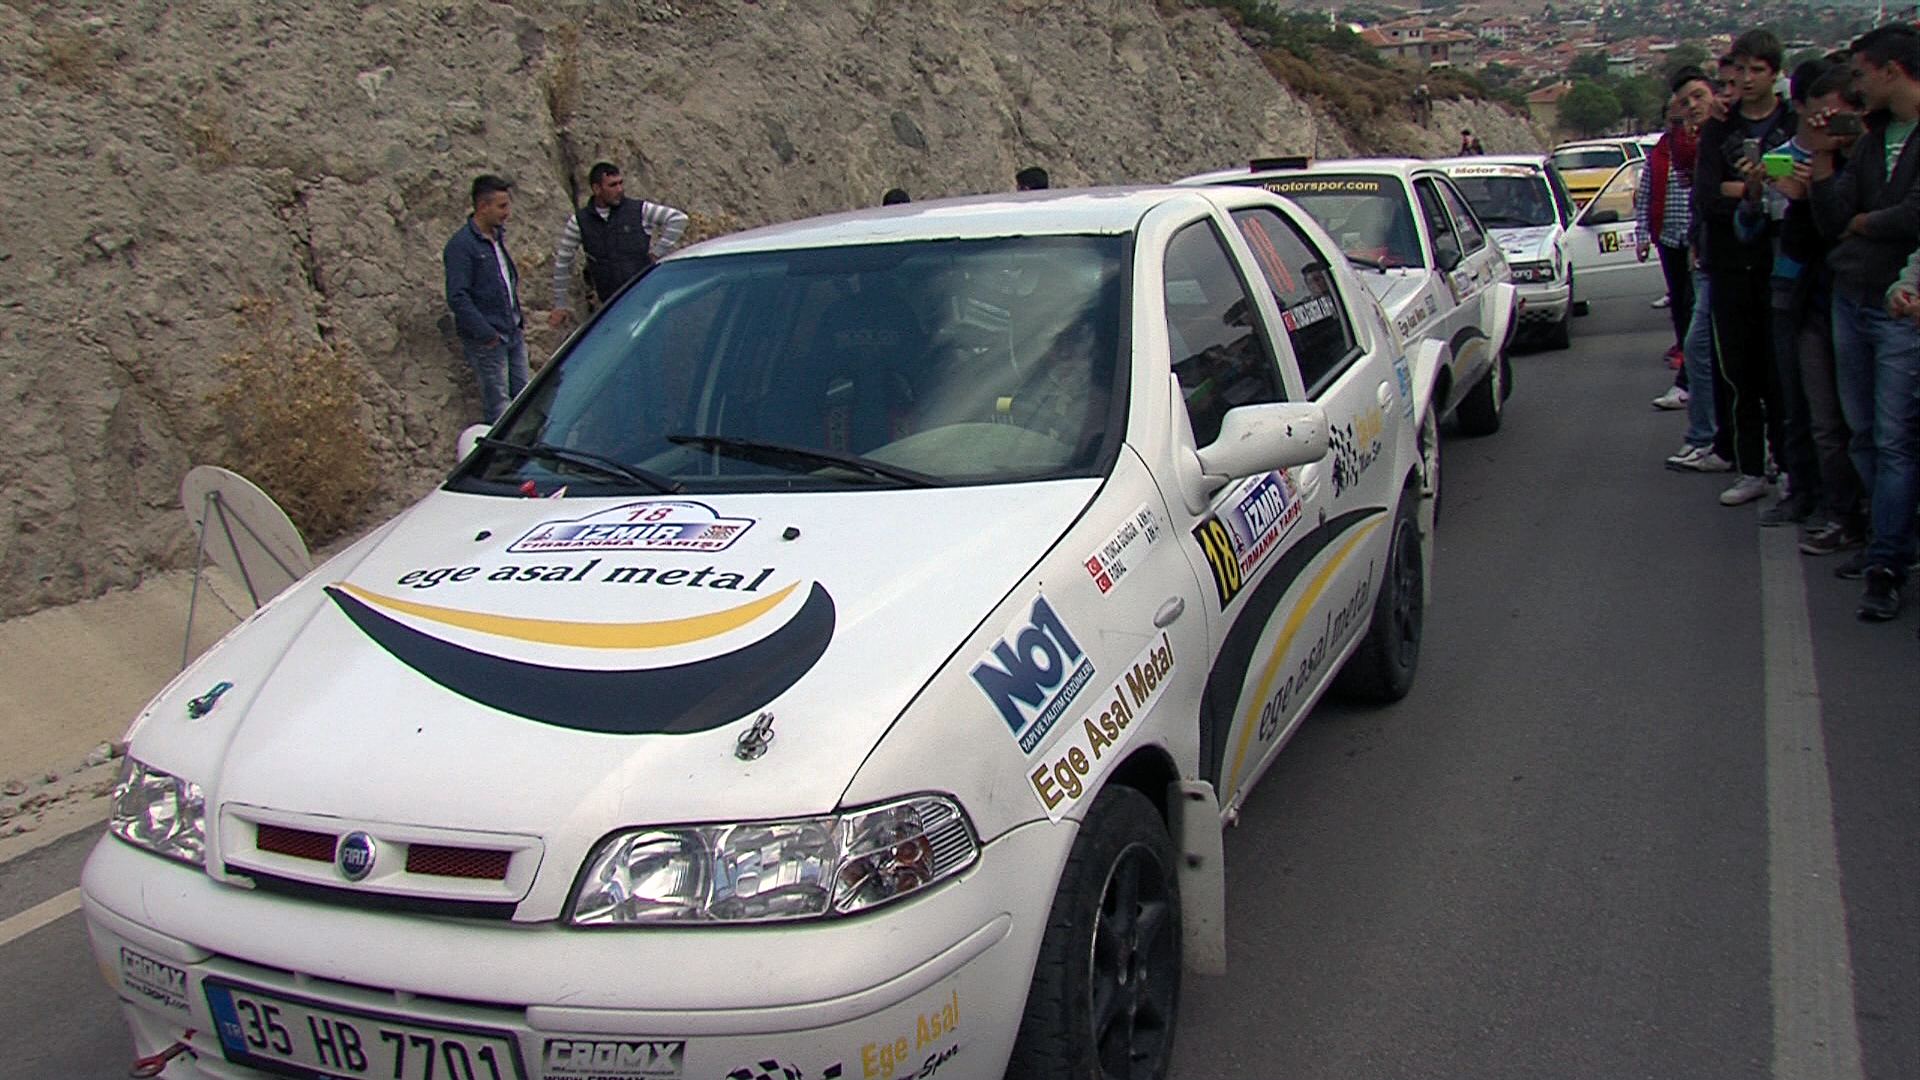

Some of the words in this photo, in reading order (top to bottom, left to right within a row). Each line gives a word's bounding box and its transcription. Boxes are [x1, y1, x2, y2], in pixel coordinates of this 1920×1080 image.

[1600, 233, 1618, 252] 12
[627, 508, 674, 521] 18
[1240, 483, 1285, 541] İZMİR
[520, 540, 635, 549] TIRMANMA
[1200, 519, 1240, 600] 18
[1240, 526, 1279, 577] TIRMANMA
[397, 566, 481, 588] ege
[487, 559, 602, 582] asal
[602, 566, 775, 592] metal
[1259, 675, 1294, 742] ege
[1295, 609, 1332, 695] asal
[1330, 559, 1374, 649] metal
[1020, 732, 1039, 752] YAPI
[1036, 721, 1047, 736] VE
[1043, 697, 1066, 727] YALITIM
[1031, 746, 1090, 811] Ege
[1083, 684, 1134, 761] Asal
[1124, 631, 1175, 709] Metal
[343, 847, 369, 866] FIAT
[123, 949, 186, 994] CROMX
[223, 1022, 242, 1040] TR
[237, 999, 294, 1056] 35
[307, 1014, 369, 1072] HB
[379, 1029, 502, 1080] 7701
[550, 1041, 680, 1070] CROMX
[861, 1035, 909, 1079] Ege
[915, 988, 960, 1051] Asal
